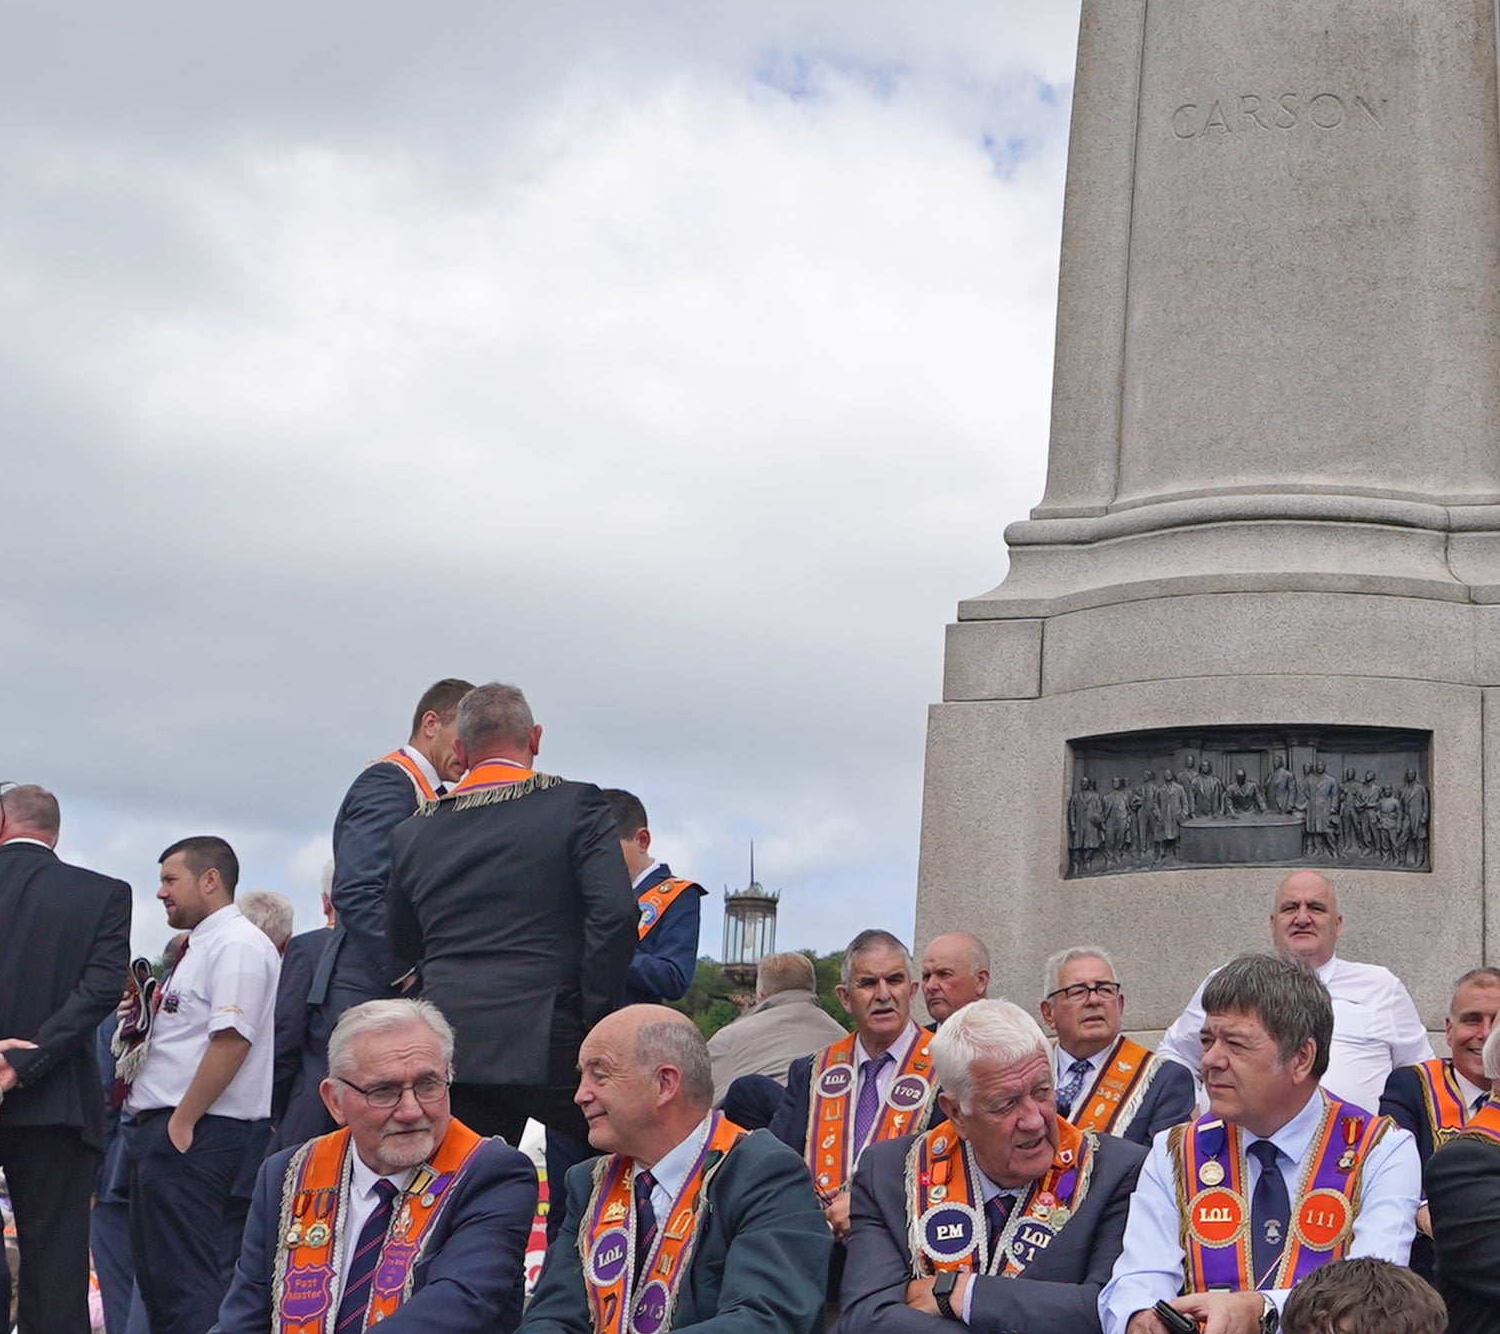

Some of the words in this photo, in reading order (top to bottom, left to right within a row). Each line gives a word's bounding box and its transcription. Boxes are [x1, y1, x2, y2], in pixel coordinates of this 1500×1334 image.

[1171, 92, 1388, 142] CARSON
[825, 1073, 847, 1086] LOL
[894, 1085, 922, 1100] 1702
[1199, 1207, 1233, 1223] LOL
[1305, 1209, 1335, 1229] 111
[936, 1223, 964, 1241] PM
[597, 1244, 624, 1269] LOL
[294, 1277, 318, 1288] Past
[287, 1290, 323, 1301] Master
